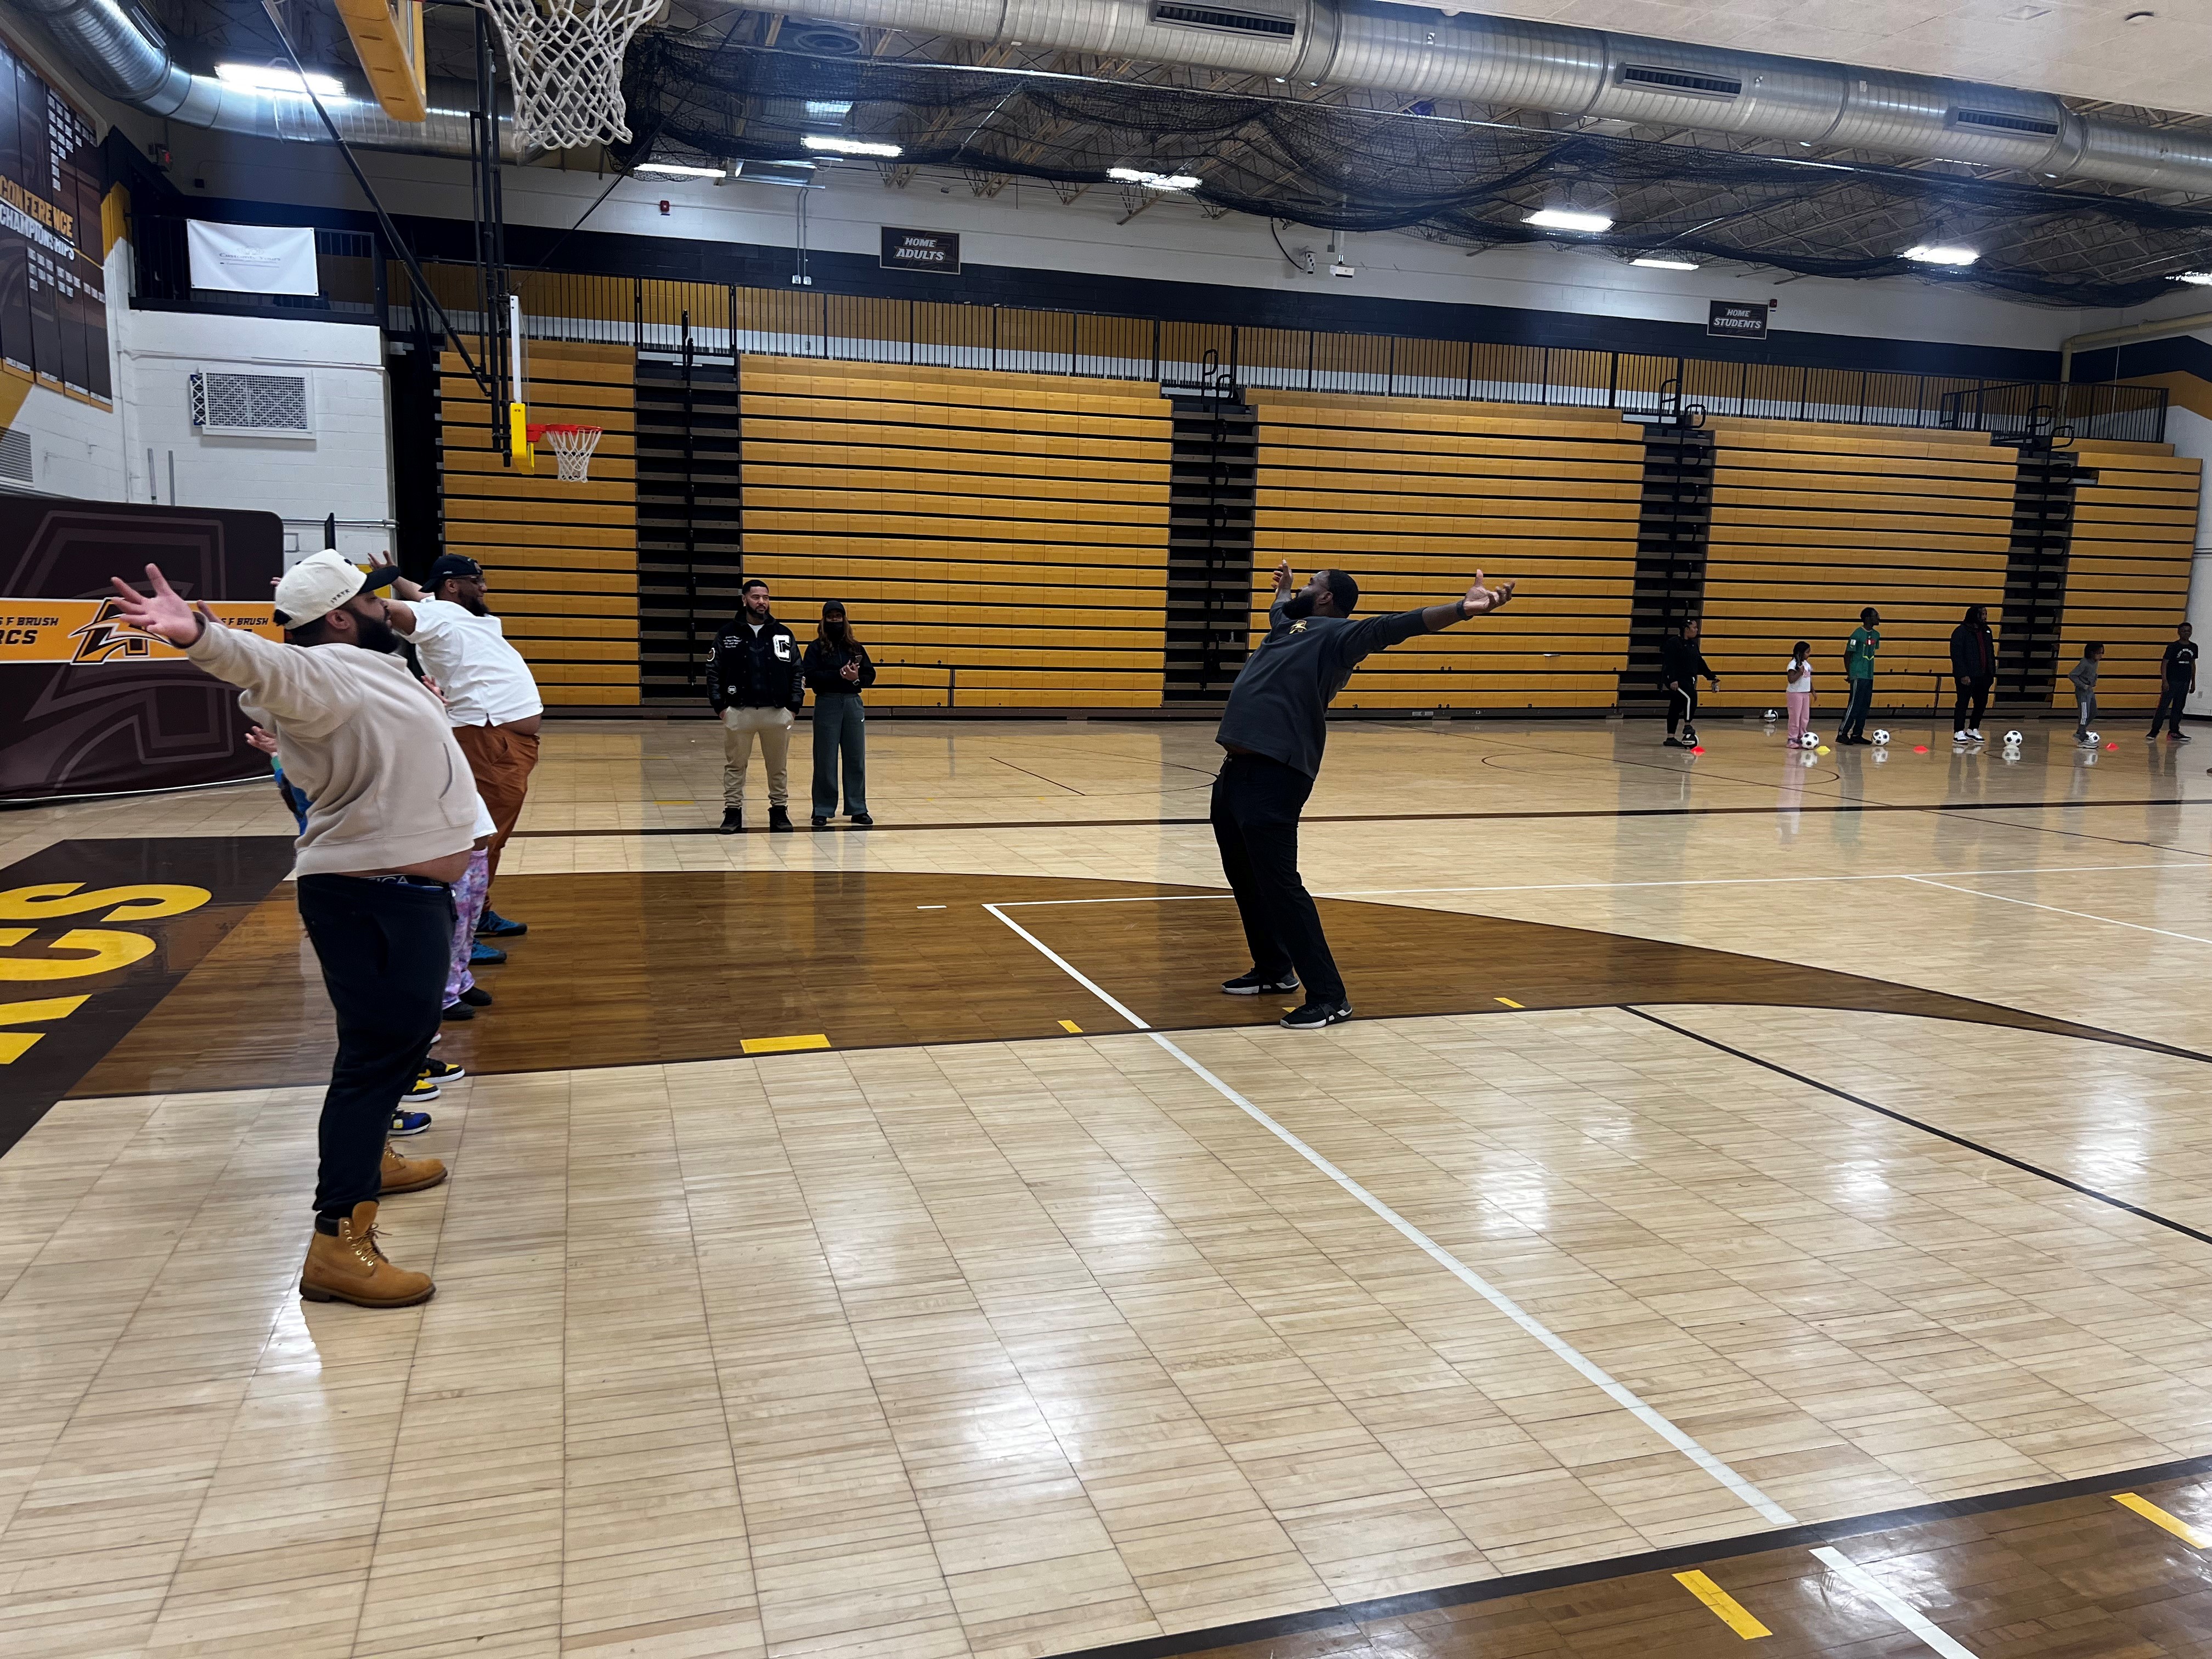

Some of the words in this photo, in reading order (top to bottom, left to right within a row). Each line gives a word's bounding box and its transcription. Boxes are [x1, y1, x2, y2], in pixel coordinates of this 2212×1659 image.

[0, 175, 74, 238] CONFERENCE
[0, 204, 75, 261] CHAMPIONSHIPS
[905, 237, 936, 247] HOME
[896, 248, 945, 261] ADULTS
[1726, 309, 1751, 317] HOME
[1713, 318, 1762, 329] STUDENTS
[6, 617, 14, 626] F
[16, 617, 59, 626] BRUSH
[772, 634, 791, 662] C
